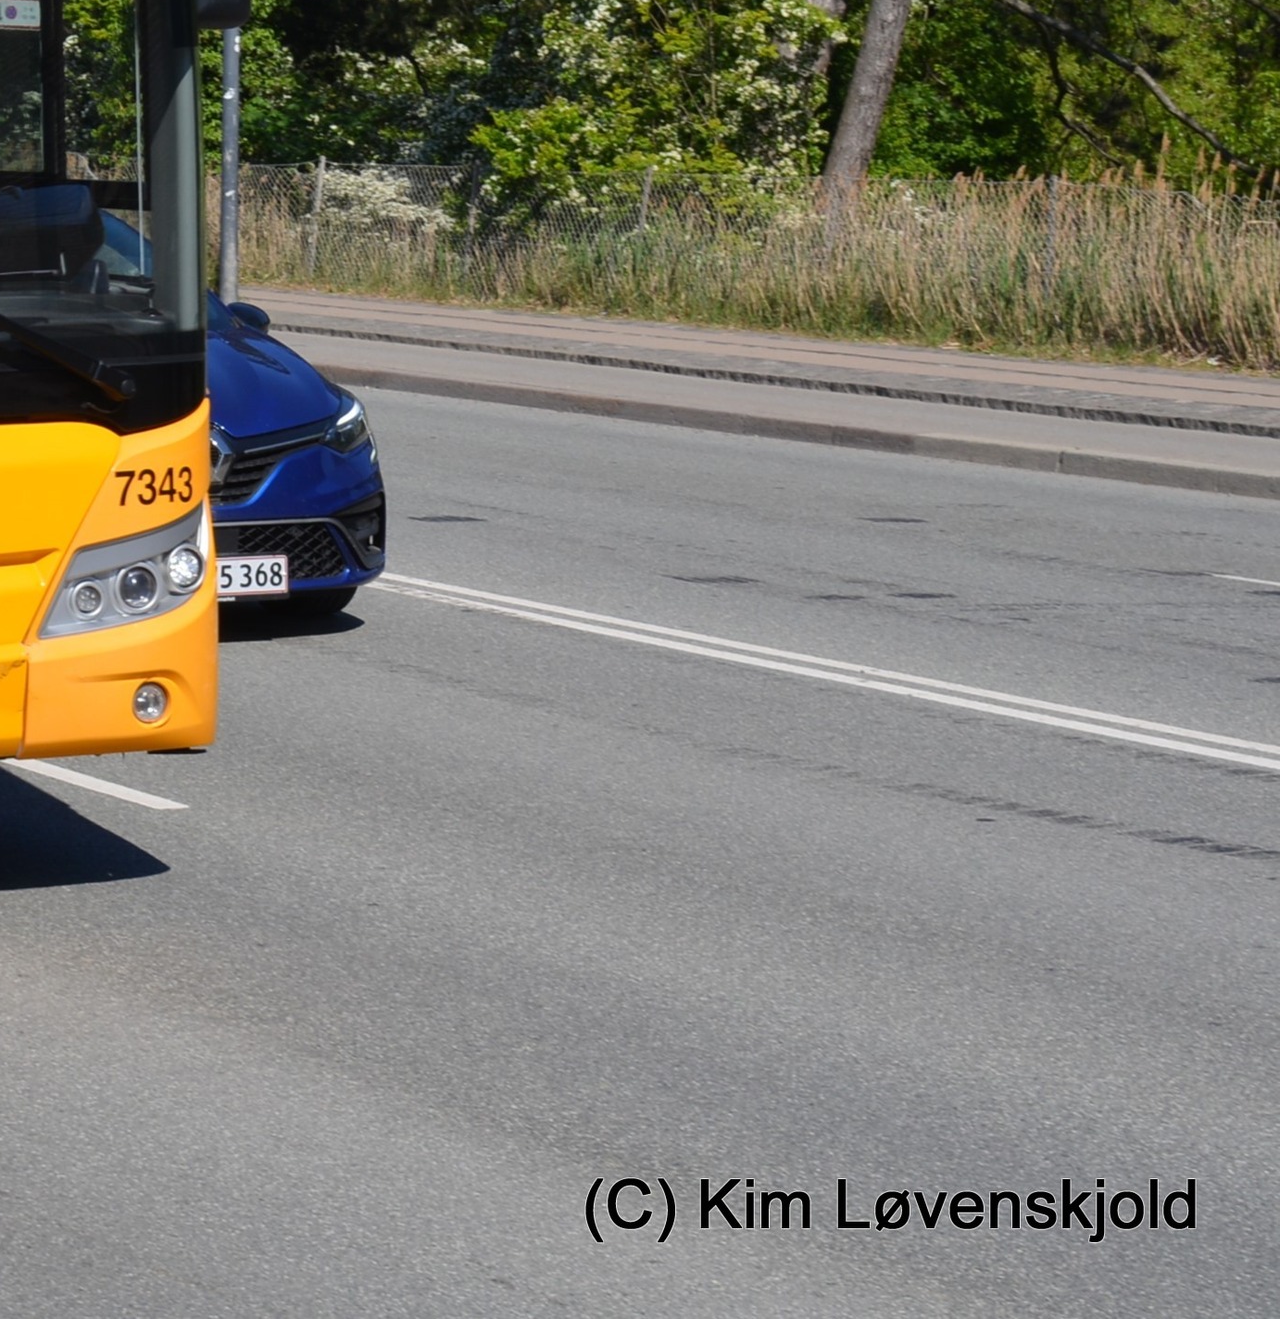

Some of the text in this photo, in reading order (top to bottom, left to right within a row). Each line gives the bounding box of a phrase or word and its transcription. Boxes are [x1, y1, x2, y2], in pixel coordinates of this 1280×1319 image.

[115, 466, 193, 506] 7343
[216, 562, 283, 588] 5 368
